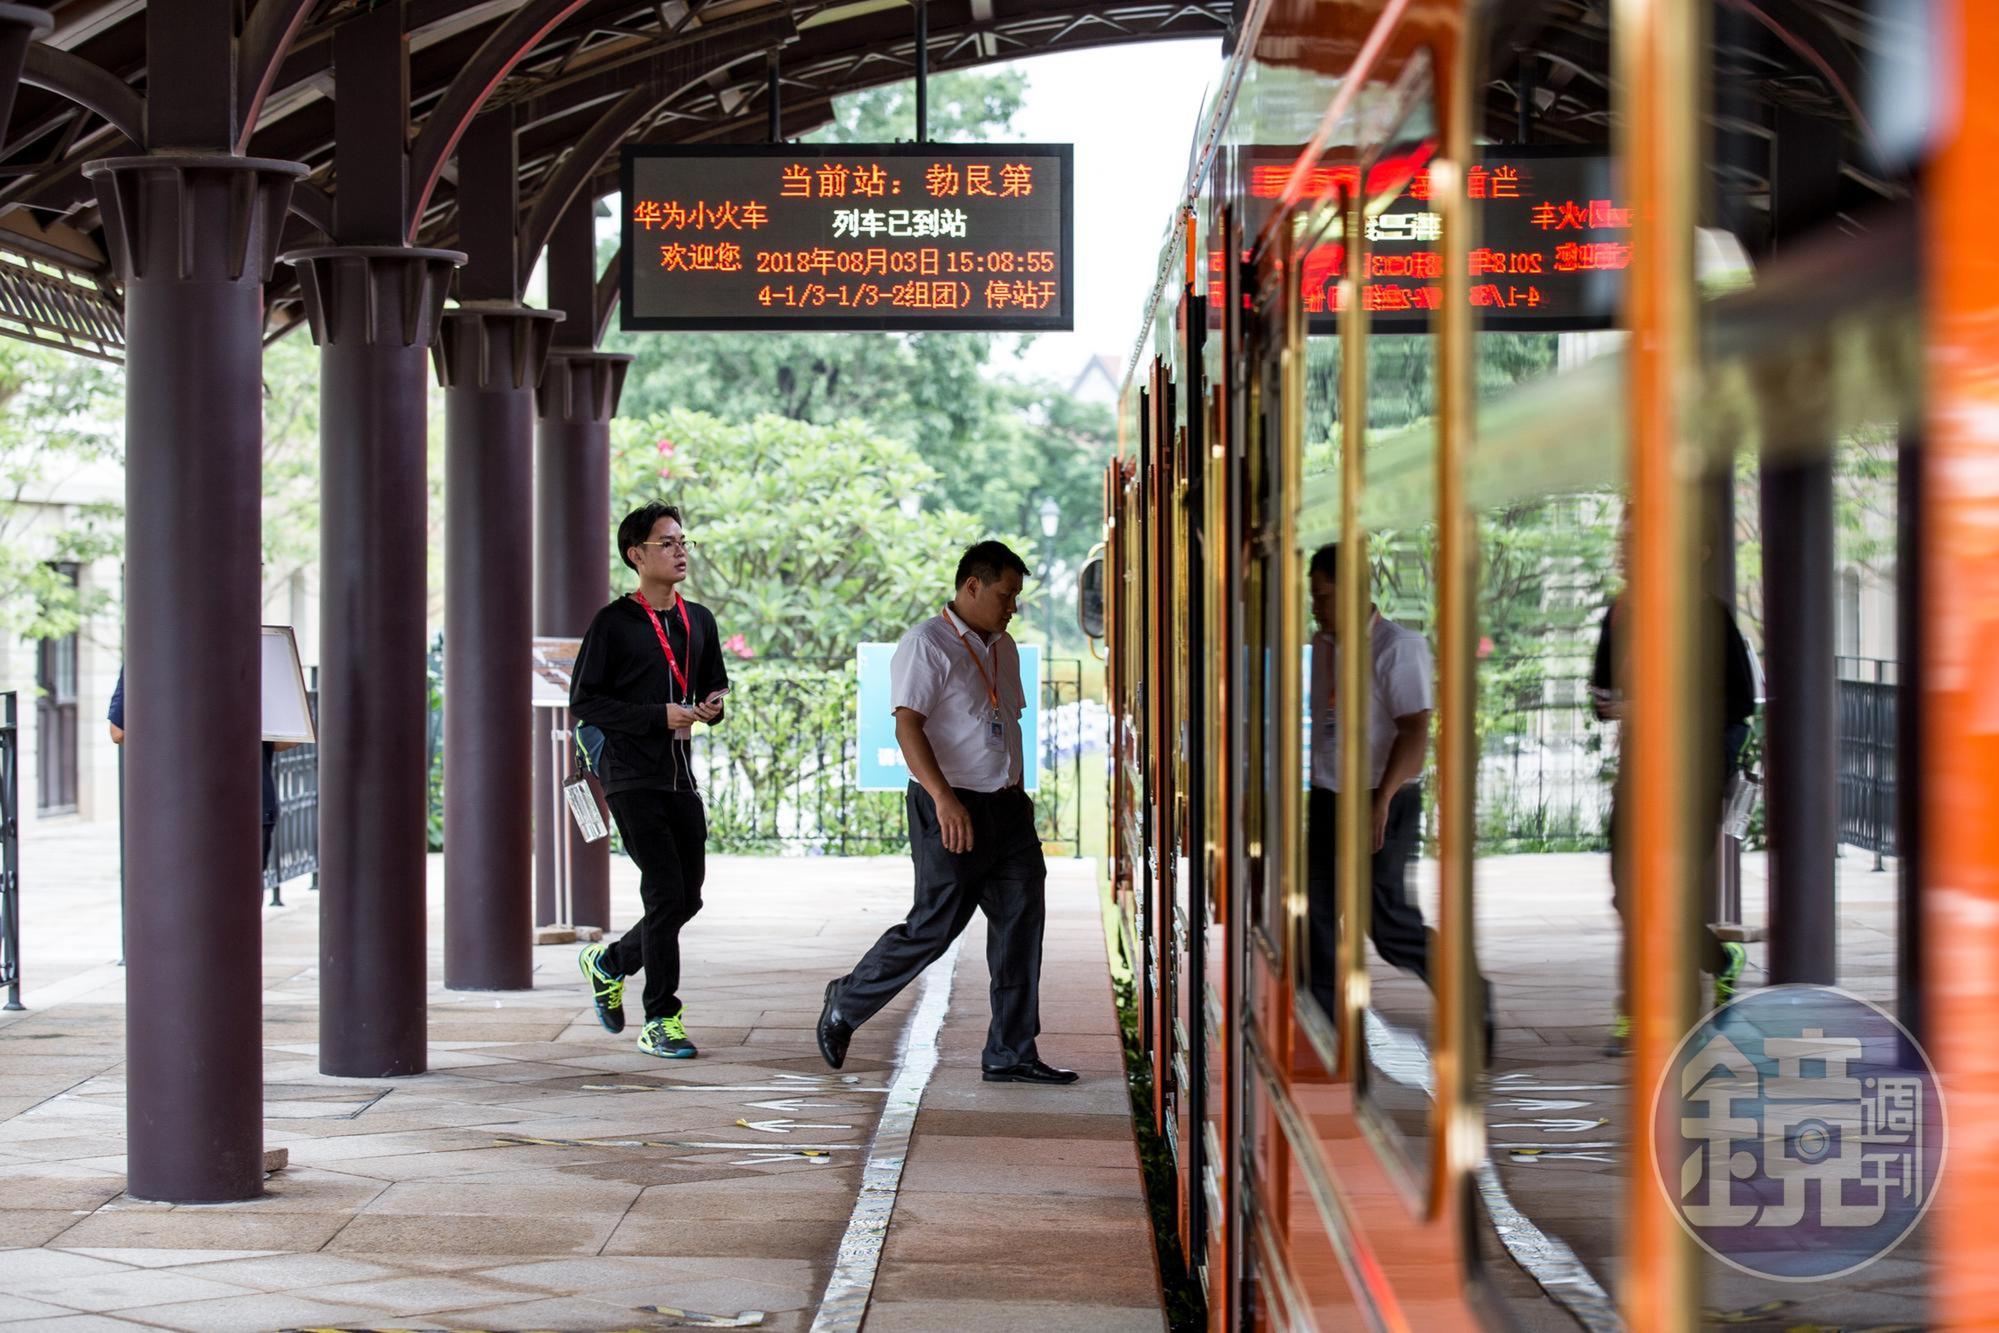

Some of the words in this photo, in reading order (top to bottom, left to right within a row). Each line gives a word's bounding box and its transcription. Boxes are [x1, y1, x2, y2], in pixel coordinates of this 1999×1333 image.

[633, 200, 769, 230] 华为小火车
[832, 208, 968, 238] 列车已到站
[660, 241, 743, 272] 欢迎您
[756, 247, 939, 276] 2018年08月03日
[947, 251, 1056, 273] 15:08:55
